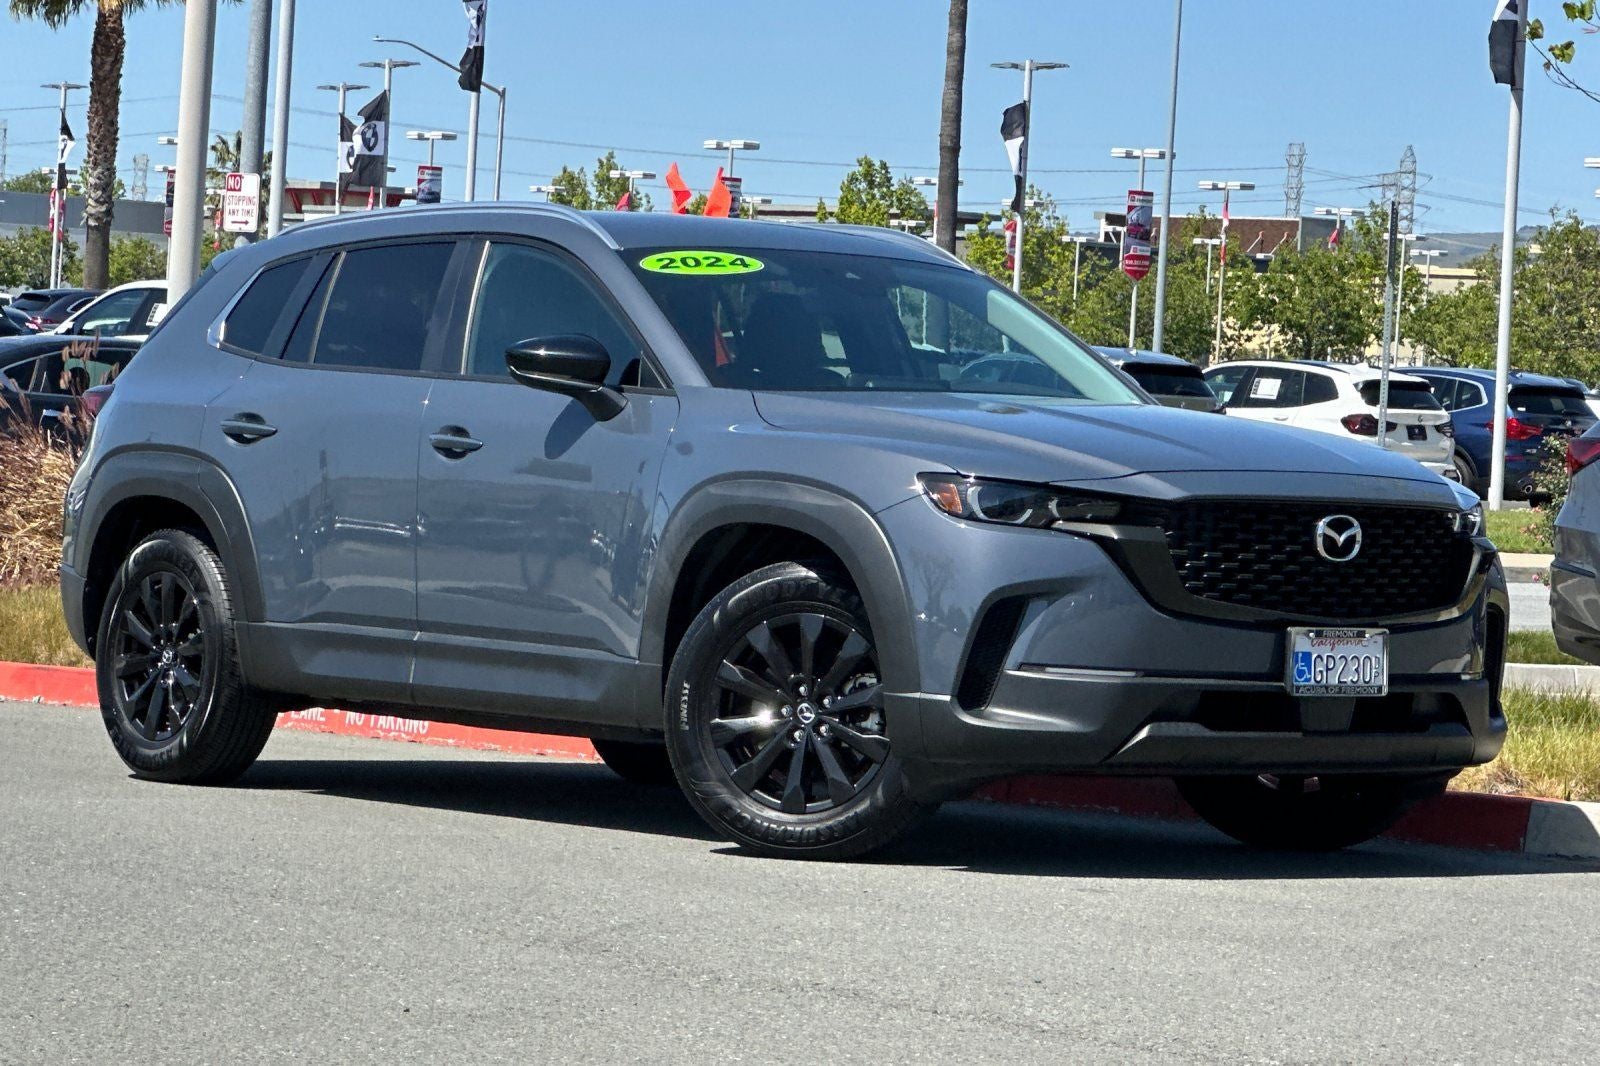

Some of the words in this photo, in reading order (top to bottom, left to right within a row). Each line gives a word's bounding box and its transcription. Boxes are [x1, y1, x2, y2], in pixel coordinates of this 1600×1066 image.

[228, 176, 241, 190] NO
[227, 195, 256, 206] STOPPING
[241, 209, 254, 217] TIME
[656, 256, 750, 269] 2024
[1313, 654, 1373, 684] GP230
[1298, 687, 1326, 695] ACURA
[1328, 687, 1340, 695] OF
[1341, 686, 1379, 695] FREMONT
[344, 711, 366, 726] NO
